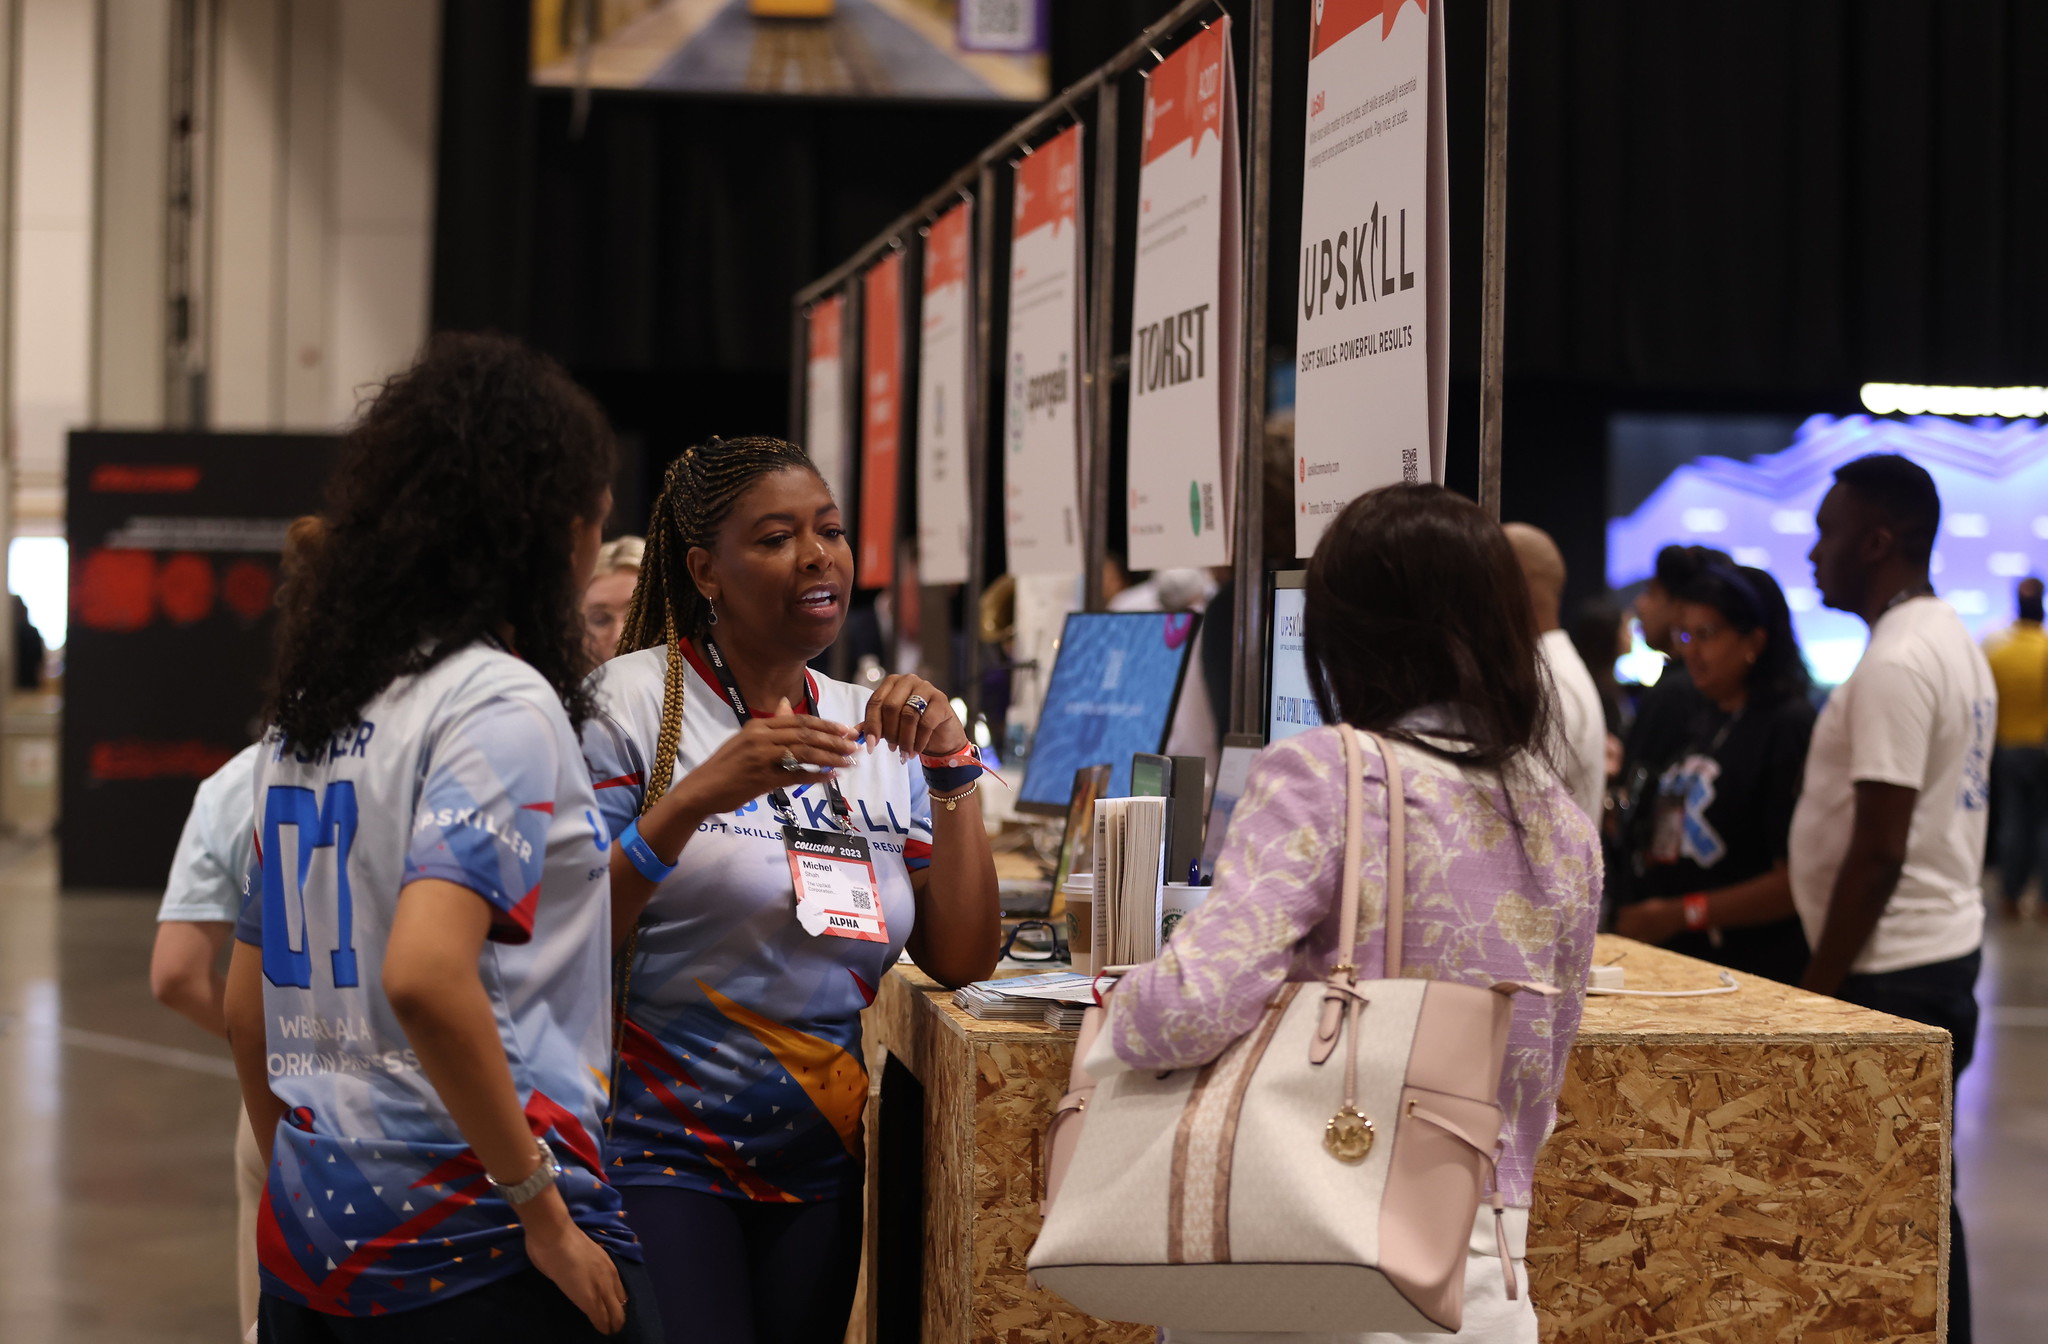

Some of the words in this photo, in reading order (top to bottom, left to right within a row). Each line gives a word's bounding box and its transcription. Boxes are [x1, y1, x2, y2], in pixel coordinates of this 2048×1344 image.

[1304, 200, 1414, 321] UPSKILL
[1137, 303, 1209, 396] TOAST
[1301, 350, 1316, 373] SOFT
[1339, 332, 1377, 363] POWERFUL
[1379, 324, 1413, 354] RESULTS
[1280, 611, 1305, 637] UPSKIL
[706, 643, 723, 668] COLLISION
[727, 686, 746, 714] COLLISION
[413, 808, 534, 864] PSKILLER
[697, 823, 728, 834] OFT
[794, 840, 836, 855] COLLISION
[839, 847, 862, 859] 2023
[802, 860, 833, 873] Michel
[829, 916, 860, 929] ALPHA
[267, 1052, 314, 1077] ORK
